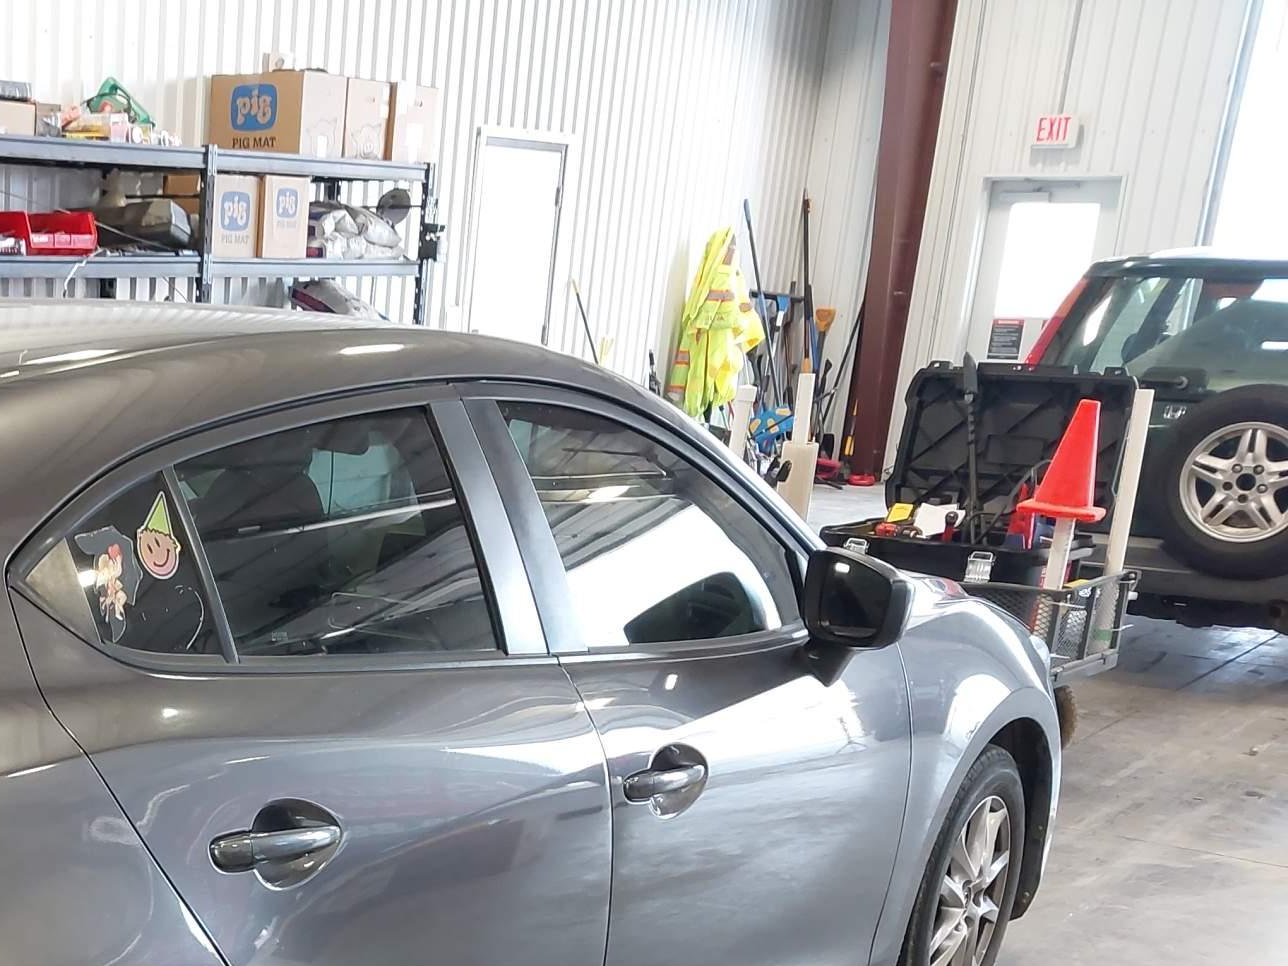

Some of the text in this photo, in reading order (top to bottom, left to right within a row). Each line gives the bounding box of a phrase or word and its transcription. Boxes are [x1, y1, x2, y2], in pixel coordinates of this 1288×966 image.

[236, 88, 272, 125] pig
[232, 137, 276, 148] PIG MAT
[1036, 117, 1072, 141] EXIT
[223, 195, 247, 225] pig
